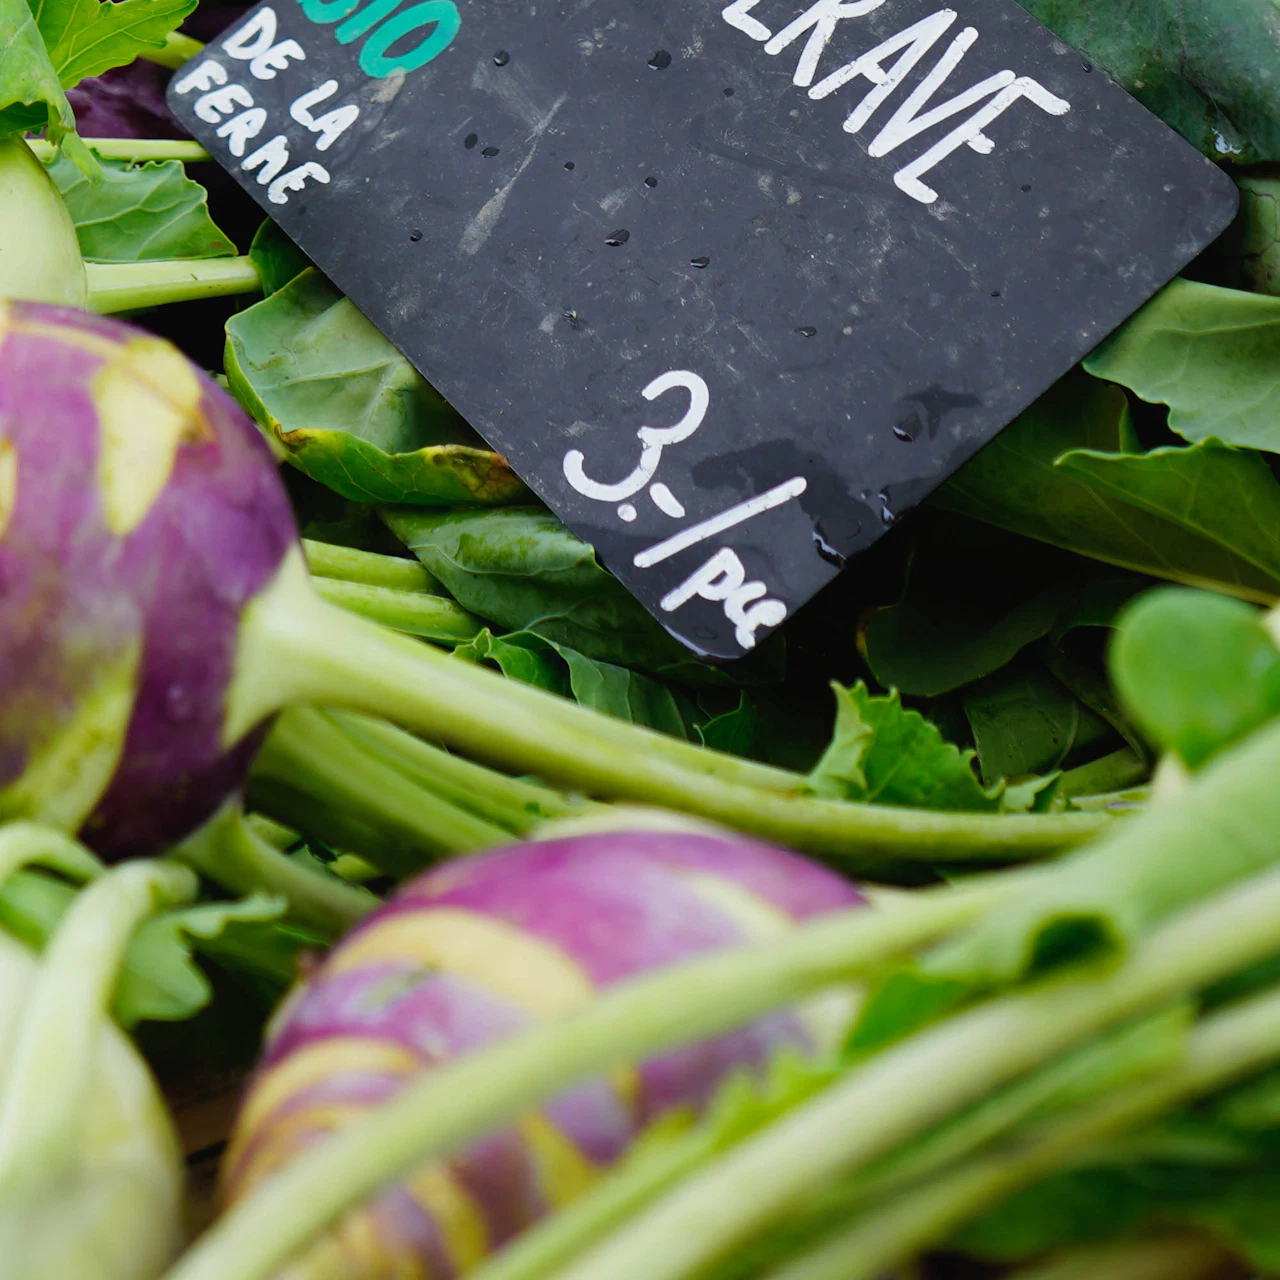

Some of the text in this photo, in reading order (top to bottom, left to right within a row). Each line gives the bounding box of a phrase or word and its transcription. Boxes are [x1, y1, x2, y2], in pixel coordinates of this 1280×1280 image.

[175, 59, 331, 205] FERME
[222, 6, 360, 151] DE LA
